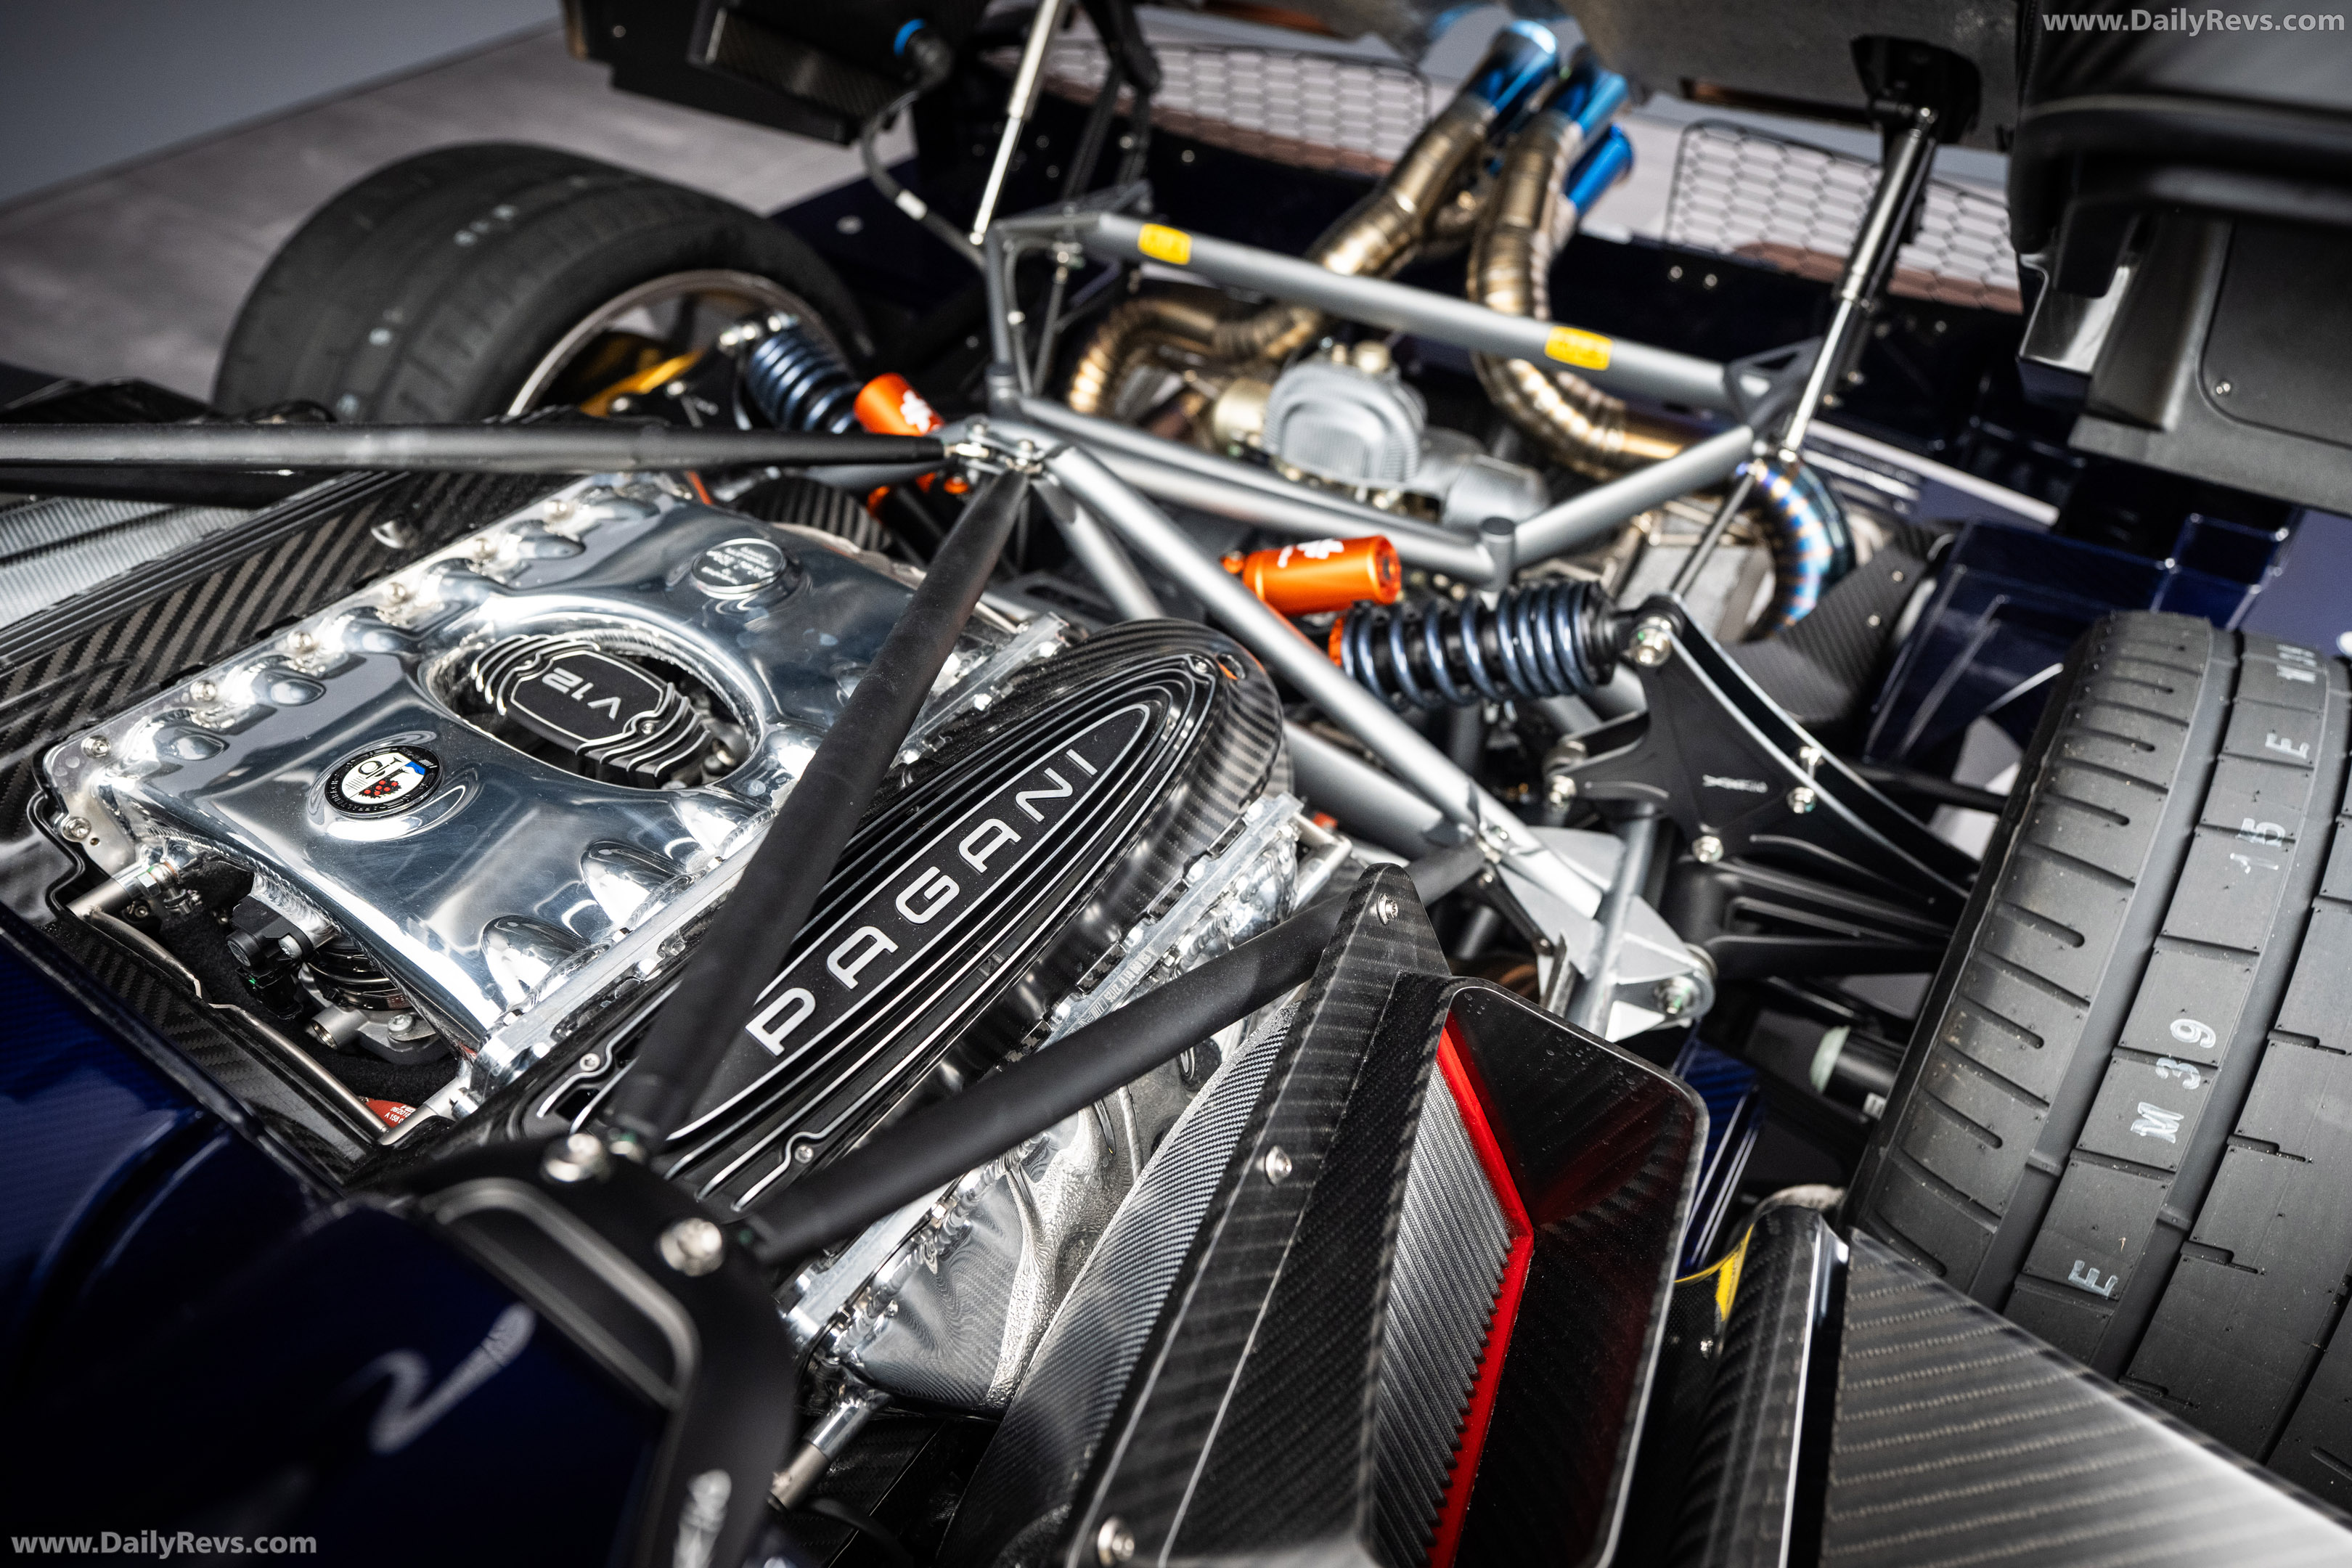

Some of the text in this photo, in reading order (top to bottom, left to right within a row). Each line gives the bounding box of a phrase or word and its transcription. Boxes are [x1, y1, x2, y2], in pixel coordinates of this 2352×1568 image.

[542, 666, 622, 721] V12
[746, 748, 1098, 1056] PAGANI
[2068, 1260, 2119, 1299] E
[2264, 732, 2311, 759] E
